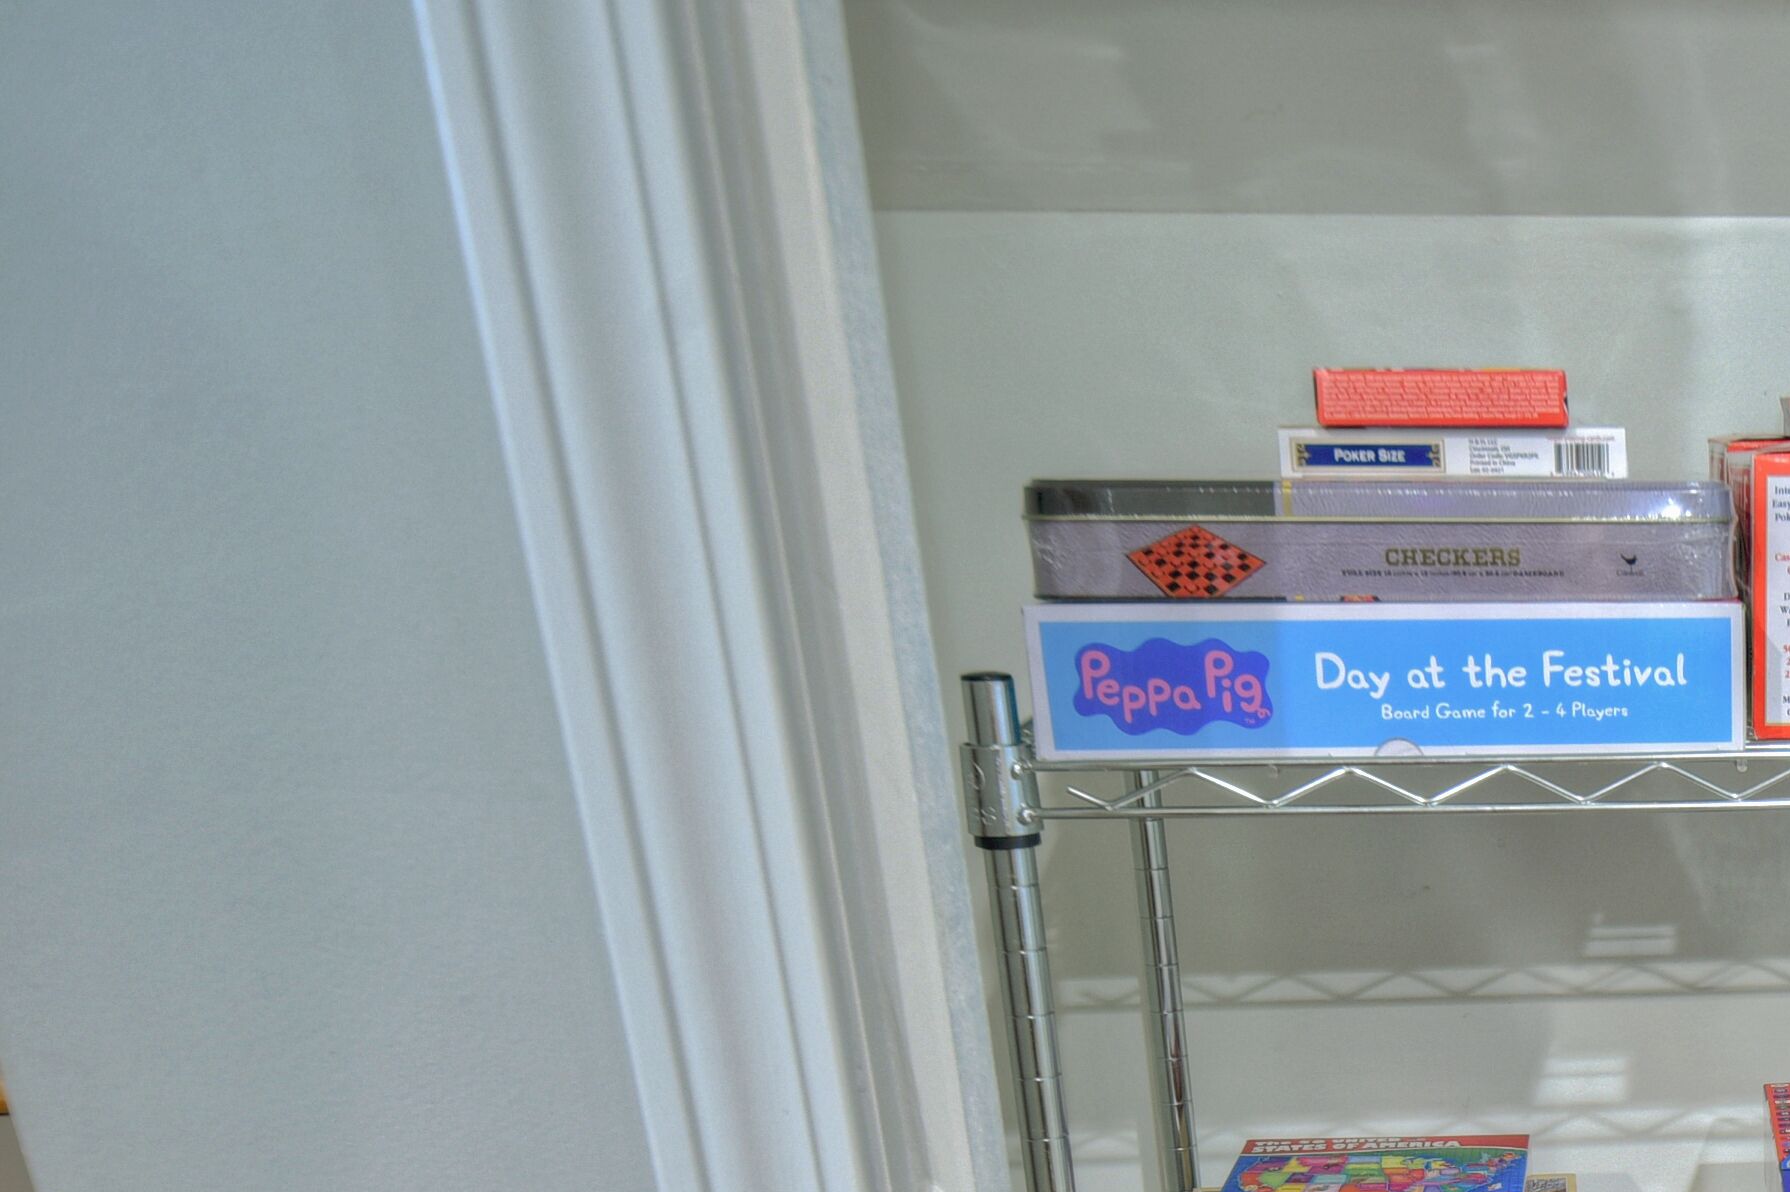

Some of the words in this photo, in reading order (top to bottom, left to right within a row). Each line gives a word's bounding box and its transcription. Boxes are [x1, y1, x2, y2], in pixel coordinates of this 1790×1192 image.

[1334, 449, 1377, 464] POKER
[1378, 449, 1406, 464] SIZE
[1385, 547, 1521, 568] CHECKERS
[1314, 651, 1391, 699] Day
[1407, 654, 1446, 689] at
[1462, 653, 1527, 688] the
[1542, 650, 1688, 688] Festival
[1080, 649, 1203, 724] Peppa
[1203, 649, 1272, 720] Pig
[1381, 704, 1430, 721] Board
[1435, 703, 1487, 720] Game
[1491, 701, 1516, 719] for
[1523, 703, 1534, 718] 2
[1556, 703, 1567, 718] 4
[1571, 702, 1629, 721] Players
[1252, 1143, 1326, 1153] STATES
[1361, 1140, 1461, 1149] AMERICA
